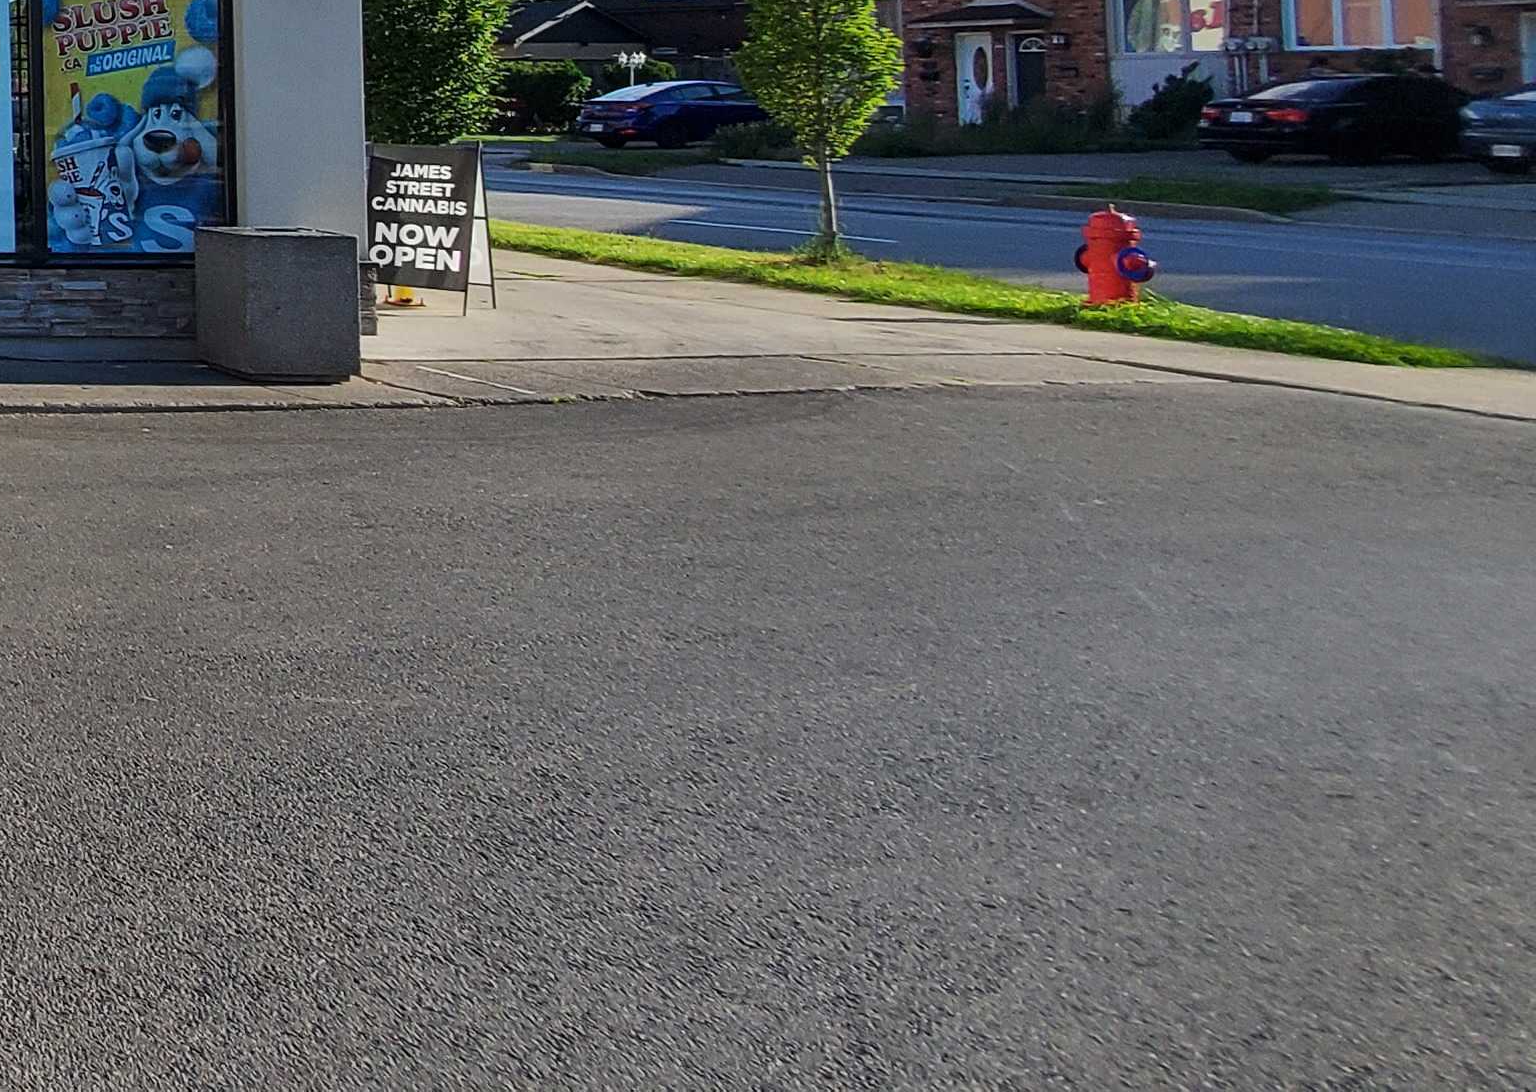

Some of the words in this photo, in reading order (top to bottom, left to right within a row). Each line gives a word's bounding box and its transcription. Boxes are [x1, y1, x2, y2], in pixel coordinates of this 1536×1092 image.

[102, 43, 172, 70] ORIGINAL
[390, 163, 453, 180] JAMES
[385, 180, 456, 197] STREET
[371, 196, 468, 216] CANNABIS
[374, 221, 461, 249] NOW
[369, 244, 462, 272] OPEN
